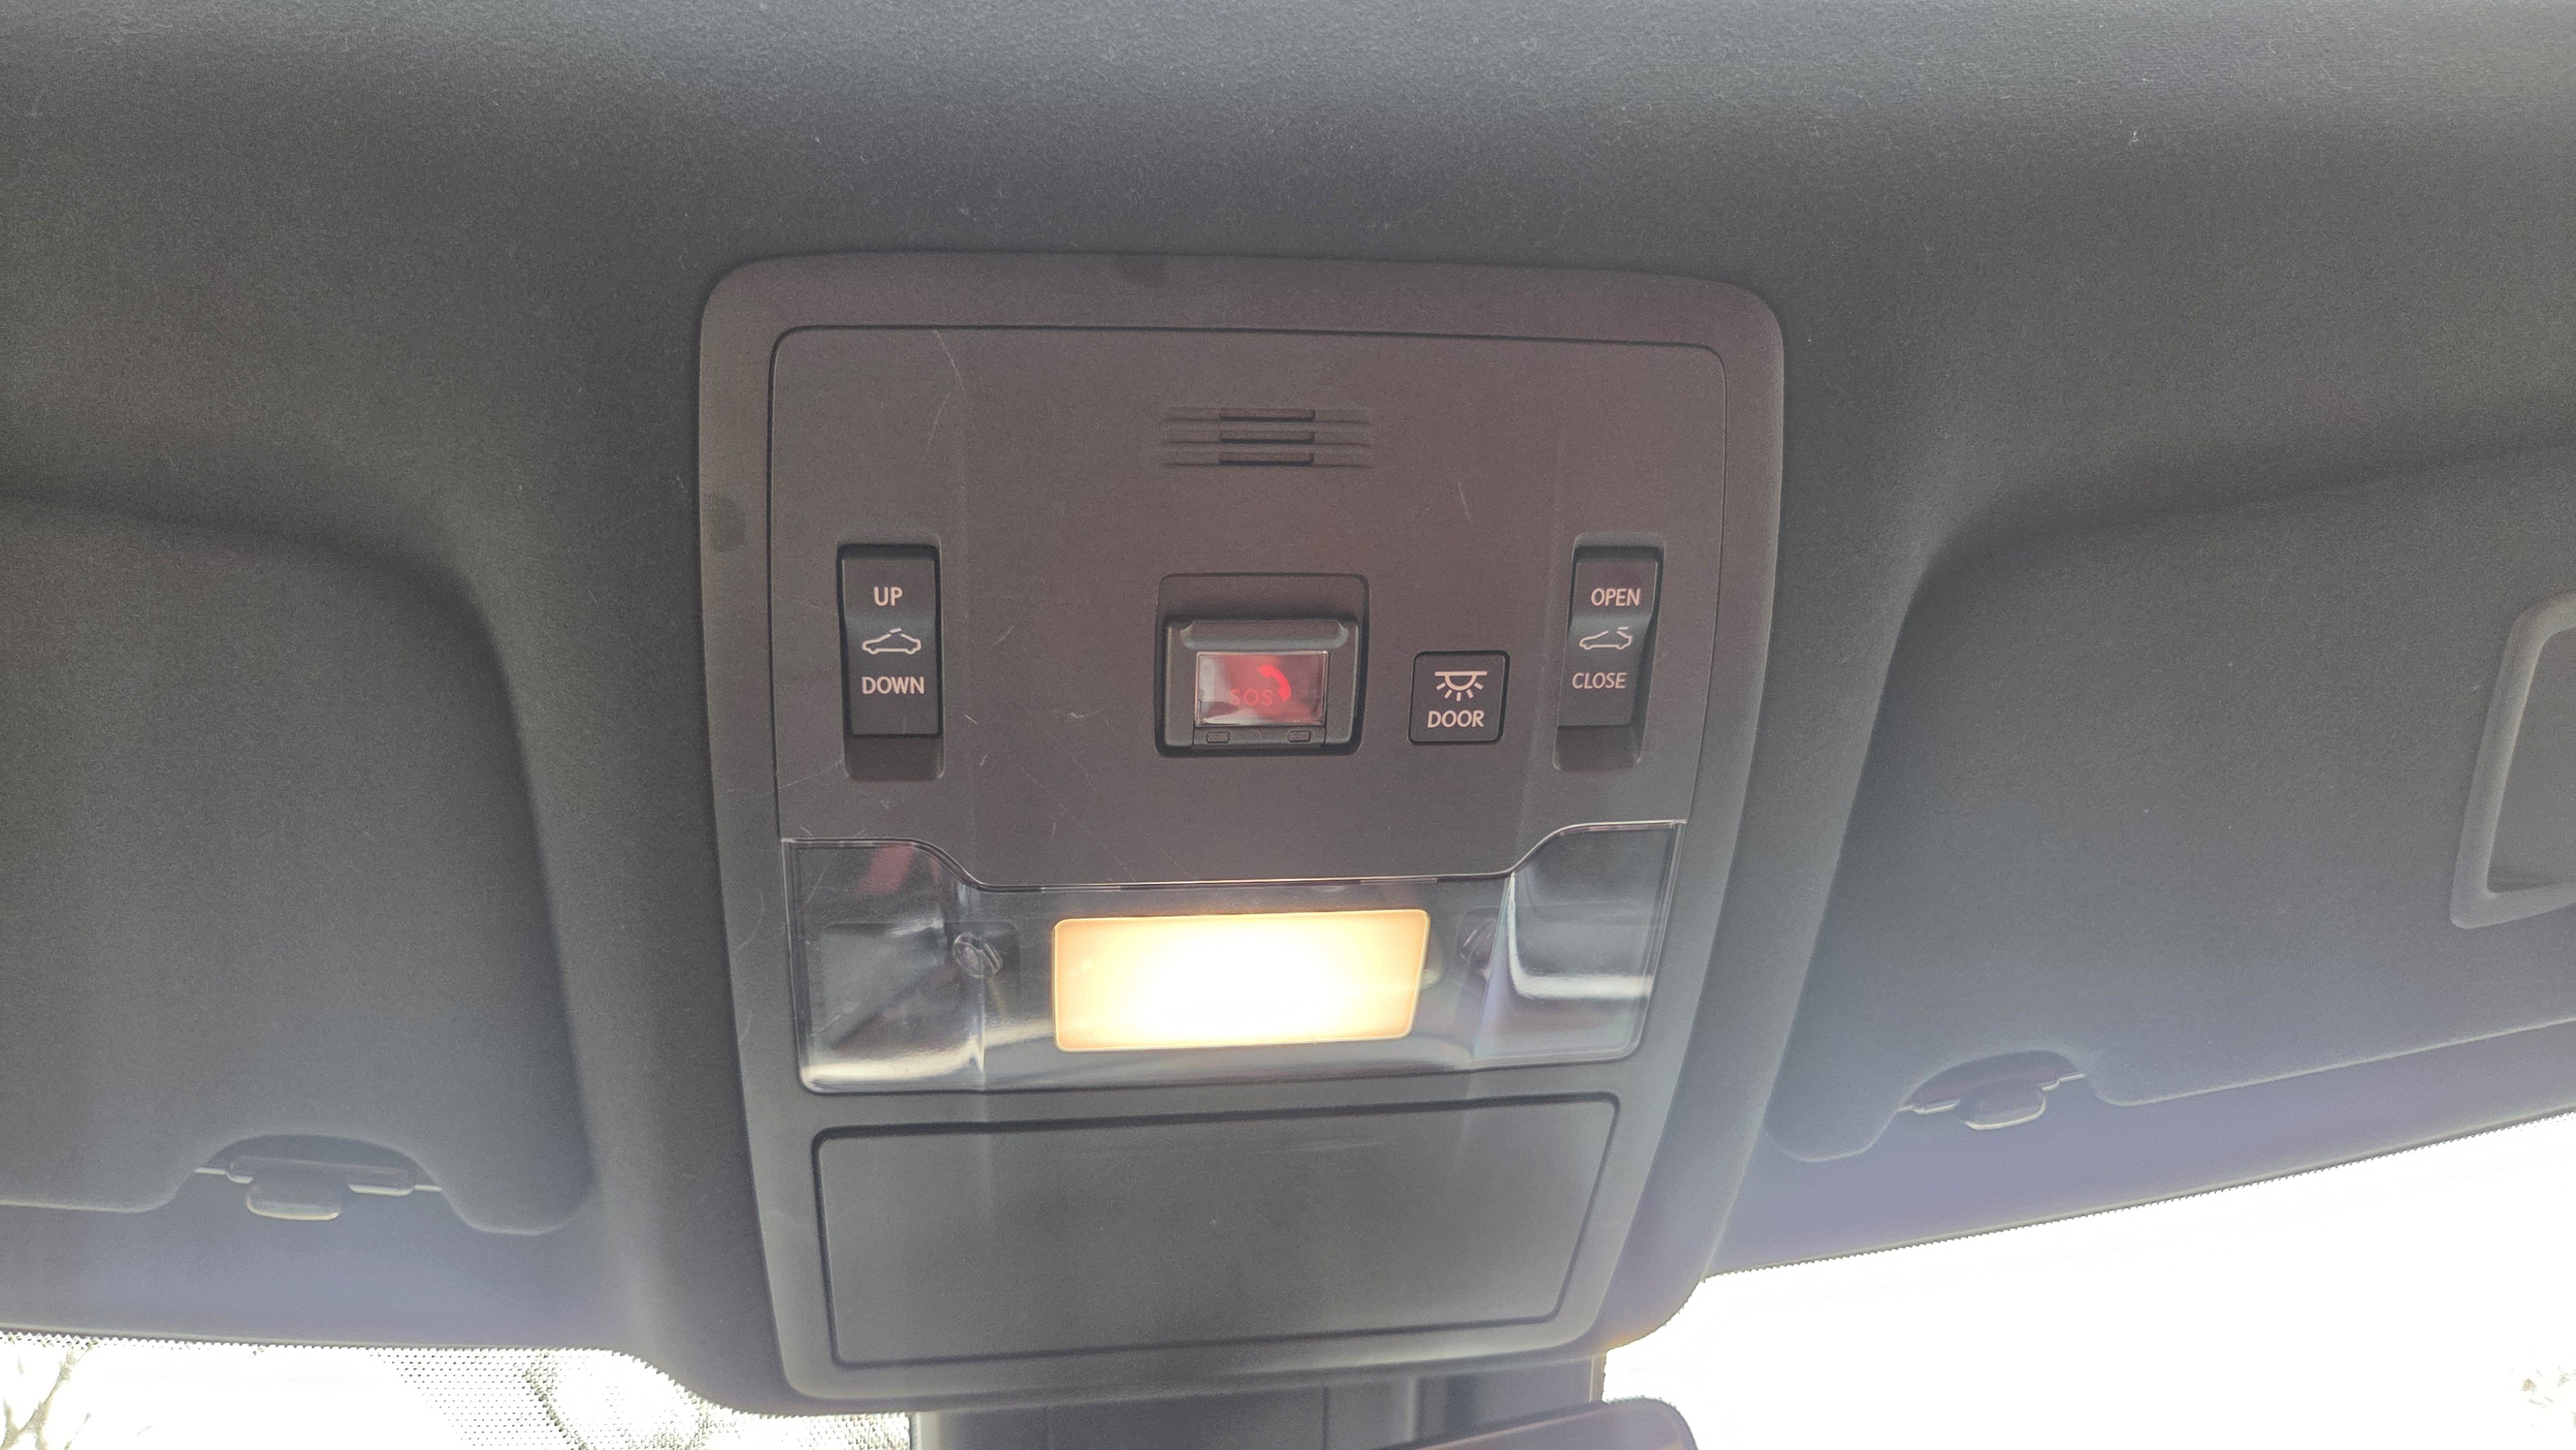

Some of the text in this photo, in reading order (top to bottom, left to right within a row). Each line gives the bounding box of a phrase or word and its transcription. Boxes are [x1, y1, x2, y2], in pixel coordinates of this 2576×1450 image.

[874, 587, 903, 606] UP
[1591, 587, 1640, 606] OPEN
[862, 676, 925, 694] DOWN
[1572, 672, 1627, 690] CLOSE
[1229, 688, 1273, 706] SOS
[1427, 710, 1484, 728] DOOR
